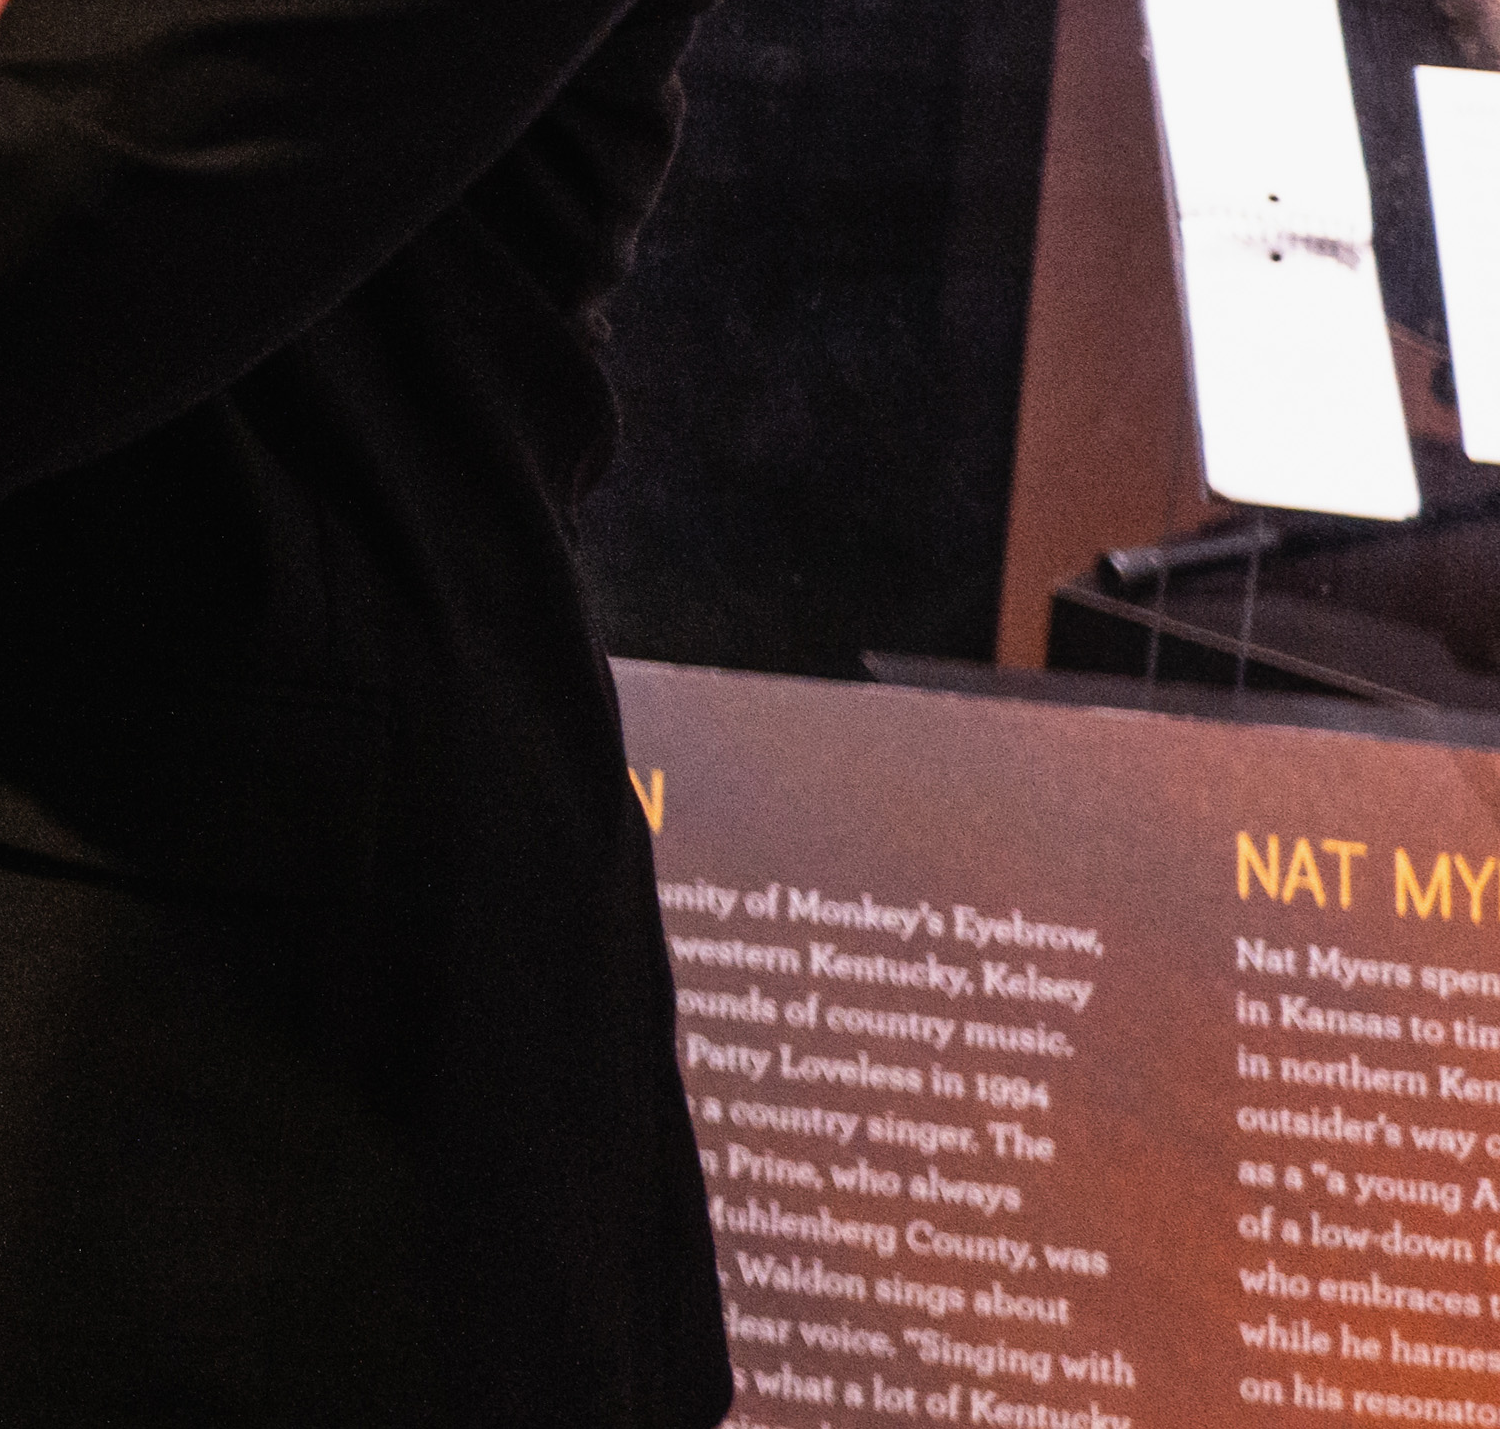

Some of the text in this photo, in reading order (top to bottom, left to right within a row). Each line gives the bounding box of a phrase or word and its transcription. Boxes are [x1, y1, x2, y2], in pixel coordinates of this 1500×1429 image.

[1235, 829, 1500, 926] NAT MY
[744, 881, 780, 921] of
[787, 886, 946, 942] Monkey's
[953, 903, 1105, 959] Eyebrow,
[671, 934, 1095, 1014] western Kentucky, Kelsey
[1235, 935, 1297, 976] Nat
[1306, 941, 1412, 992] Myers
[783, 990, 821, 1029] of
[826, 1003, 956, 1052] country
[963, 1018, 1077, 1059] music.
[1235, 990, 1271, 1027] in
[1279, 993, 1402, 1040] Kansas
[1409, 1015, 1445, 1047] to
[686, 1031, 1050, 1113] Patty Loveless in 1994
[1235, 1043, 1271, 1080] in
[1279, 1052, 1428, 1098] northern
[701, 1103, 721, 1124] a
[730, 1097, 859, 1144] country
[866, 1110, 980, 1156] singer.
[986, 1120, 1056, 1163] The
[1235, 1104, 1403, 1148] outsider's
[1410, 1125, 1479, 1162] way
[726, 1141, 823, 1191] Prine,
[830, 1156, 902, 1197] who
[907, 1165, 1023, 1217] always
[1237, 1160, 1276, 1188] as
[1283, 1166, 1304, 1192] a
[1354, 1173, 1462, 1216] young
[904, 1219, 1037, 1272] County,
[1044, 1243, 1110, 1277] was
[1237, 1204, 1275, 1242] of
[1280, 1218, 1301, 1245] a
[1311, 1210, 1474, 1265] low-down
[735, 1250, 1071, 1327] Waldon sings about
[1238, 1260, 1310, 1298] who
[1318, 1271, 1481, 1318] embraces
[798, 1319, 898, 1358] voice.
[1060, 1349, 1137, 1389] with
[1238, 1314, 1332, 1356] while
[1339, 1322, 1382, 1361] he
[752, 1363, 836, 1406] what
[842, 1382, 866, 1409] a
[872, 1374, 918, 1416] lot
[925, 1383, 960, 1419] of
[1238, 1376, 1283, 1406] on
[1293, 1371, 1344, 1412] his
